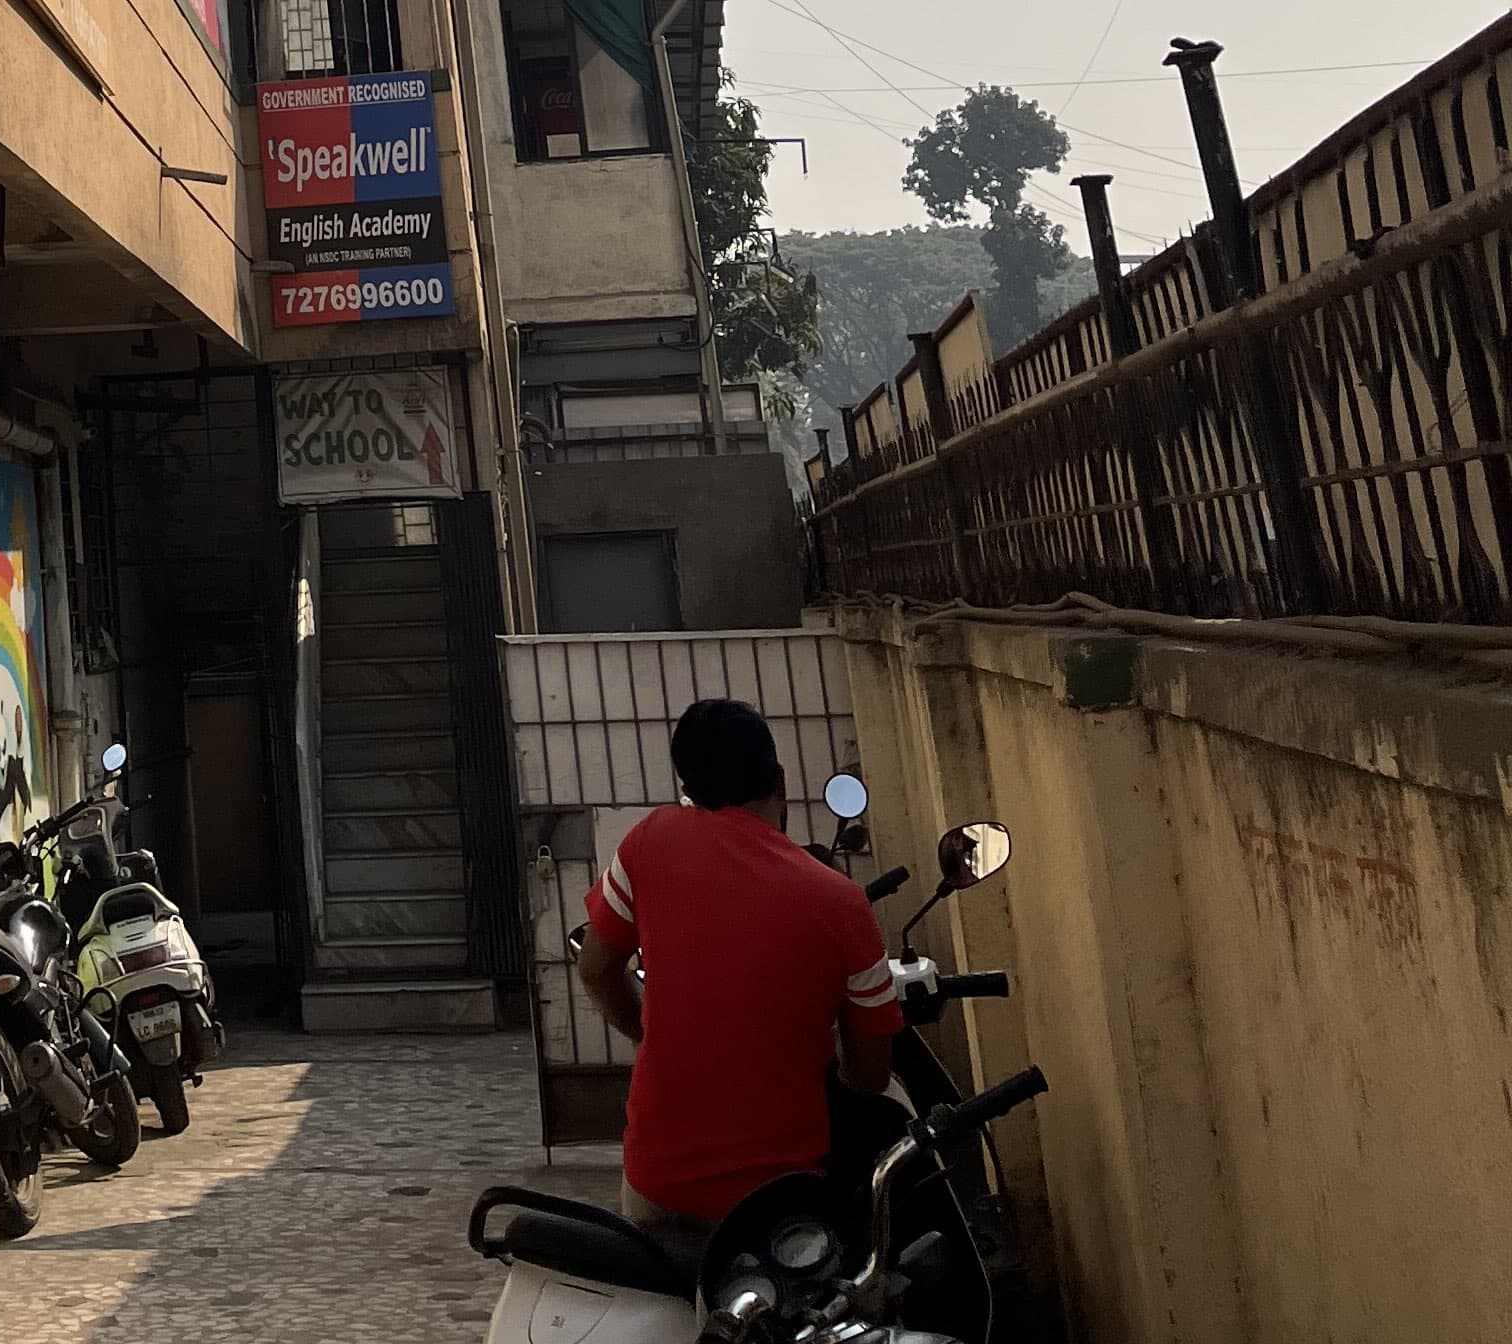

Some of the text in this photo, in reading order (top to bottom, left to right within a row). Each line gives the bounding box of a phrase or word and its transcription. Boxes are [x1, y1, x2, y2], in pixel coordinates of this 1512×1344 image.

[262, 80, 426, 109] GOVERNMENT RECOGNISED
[277, 127, 426, 192] Speakwell
[280, 209, 431, 248] English Academy
[305, 245, 412, 266] (AN NSDC TRAINING PARTNER)
[281, 278, 443, 314] 7276996600
[279, 391, 337, 420] WAY
[345, 388, 385, 415] TO
[284, 428, 415, 467] SCHOOL
